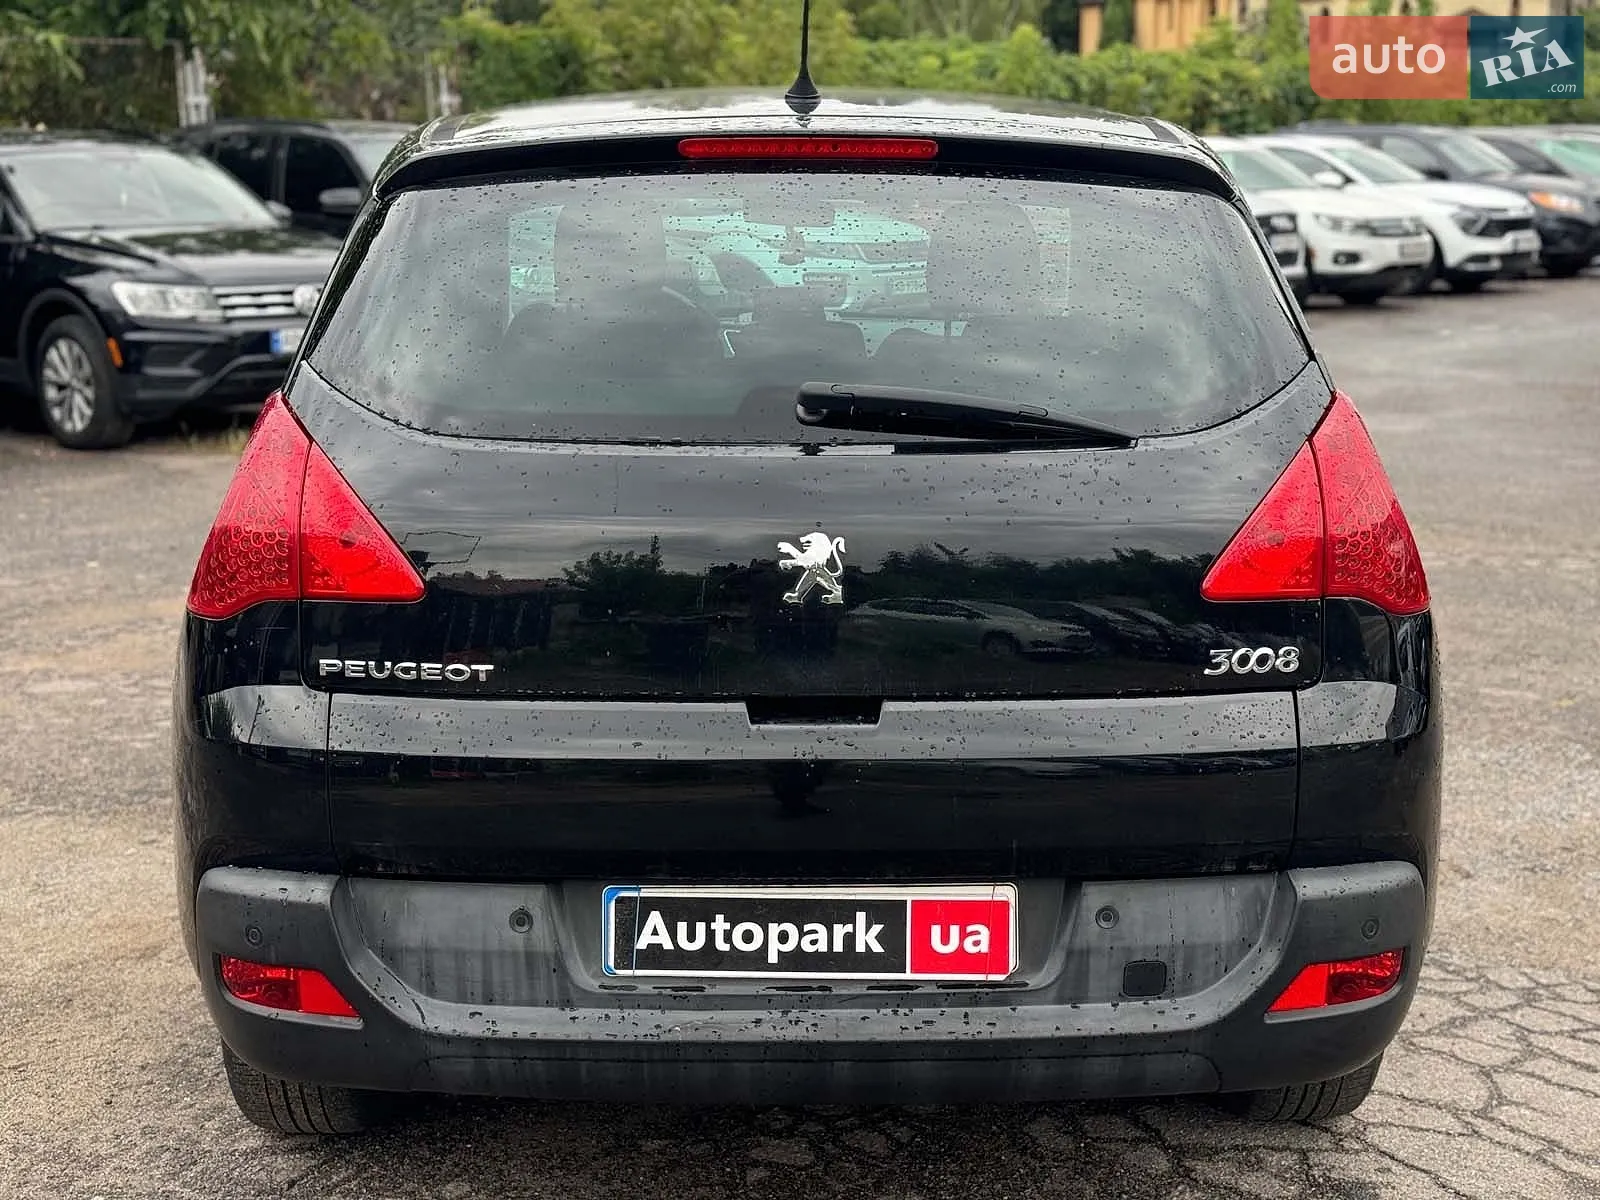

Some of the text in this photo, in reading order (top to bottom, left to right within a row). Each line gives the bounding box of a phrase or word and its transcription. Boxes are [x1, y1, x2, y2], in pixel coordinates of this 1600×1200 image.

[318, 659, 495, 682] PEUGEOT
[1203, 646, 1300, 676] 3008
[636, 910, 991, 963] Autopark ua
